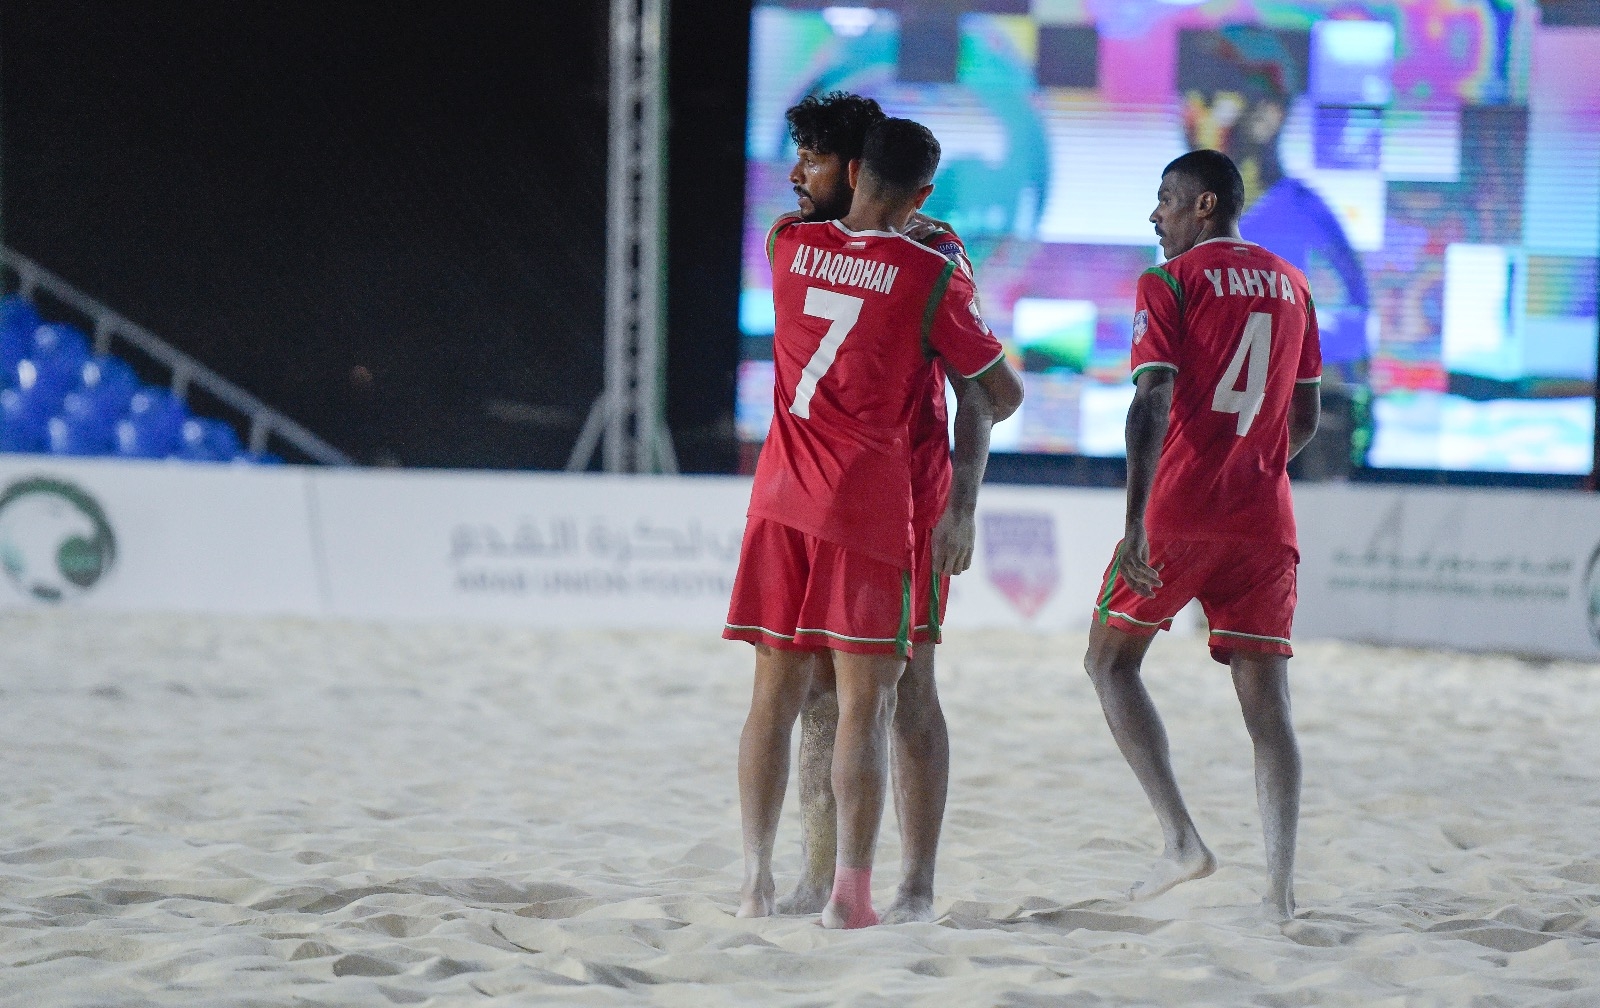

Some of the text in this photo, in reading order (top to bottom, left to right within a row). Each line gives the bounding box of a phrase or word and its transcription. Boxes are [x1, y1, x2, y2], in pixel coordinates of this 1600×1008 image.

[1204, 267, 1296, 305] YAHYA
[788, 286, 865, 420] 7
[1211, 311, 1273, 437] 4
